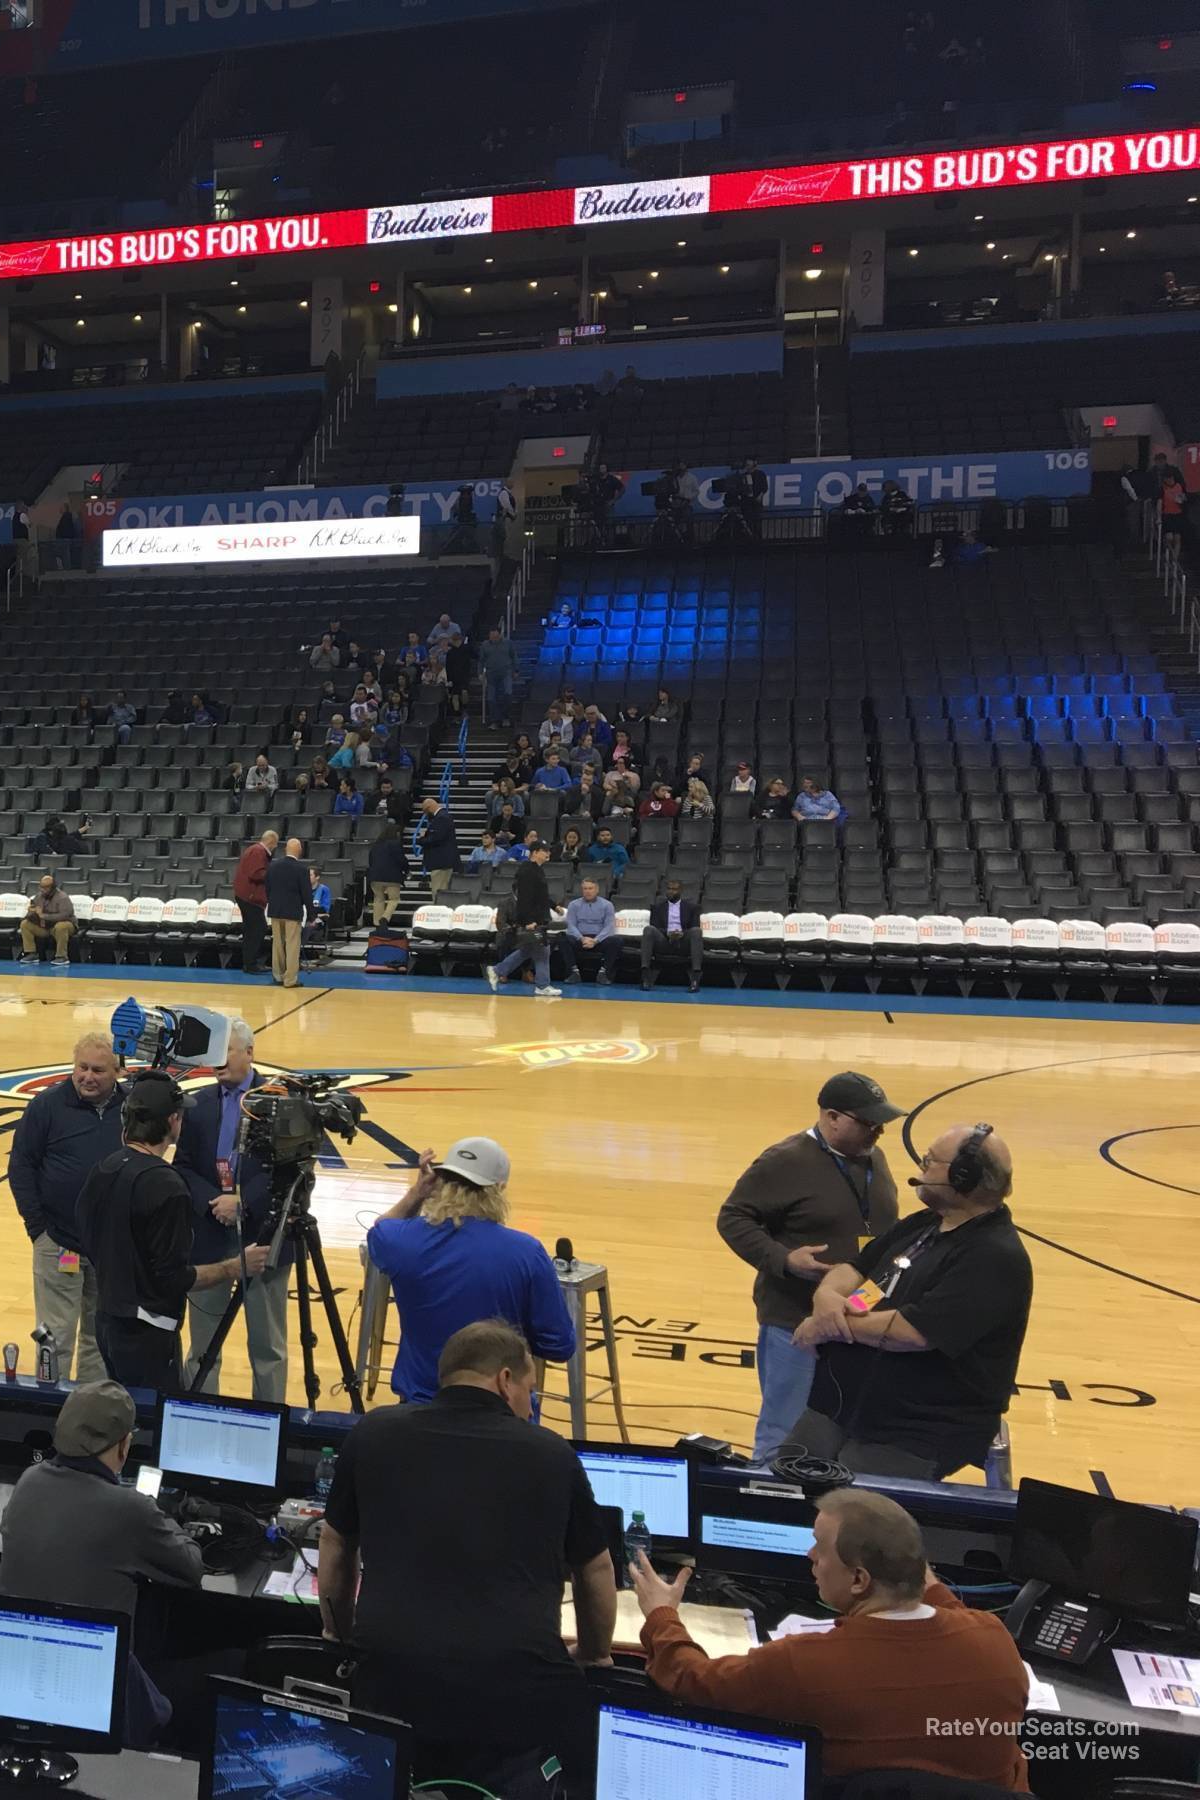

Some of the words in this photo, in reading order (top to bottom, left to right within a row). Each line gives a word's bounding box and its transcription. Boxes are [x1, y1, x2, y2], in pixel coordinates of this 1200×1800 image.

[848, 158, 923, 196] THIS
[933, 148, 1038, 189] BUD'S
[1046, 141, 1115, 179] FOR
[580, 178, 706, 221] Budweiser
[370, 205, 488, 241] Budweiser
[56, 238, 113, 270] THIS
[120, 229, 200, 264] BUD'S
[206, 224, 259, 255] FOR
[265, 217, 329, 248] YOU.
[1045, 452, 1088, 470] 106
[899, 465, 997, 500] THE
[85, 501, 116, 516] 105
[362, 491, 461, 522] CTY
[216, 535, 297, 551] SHARP
